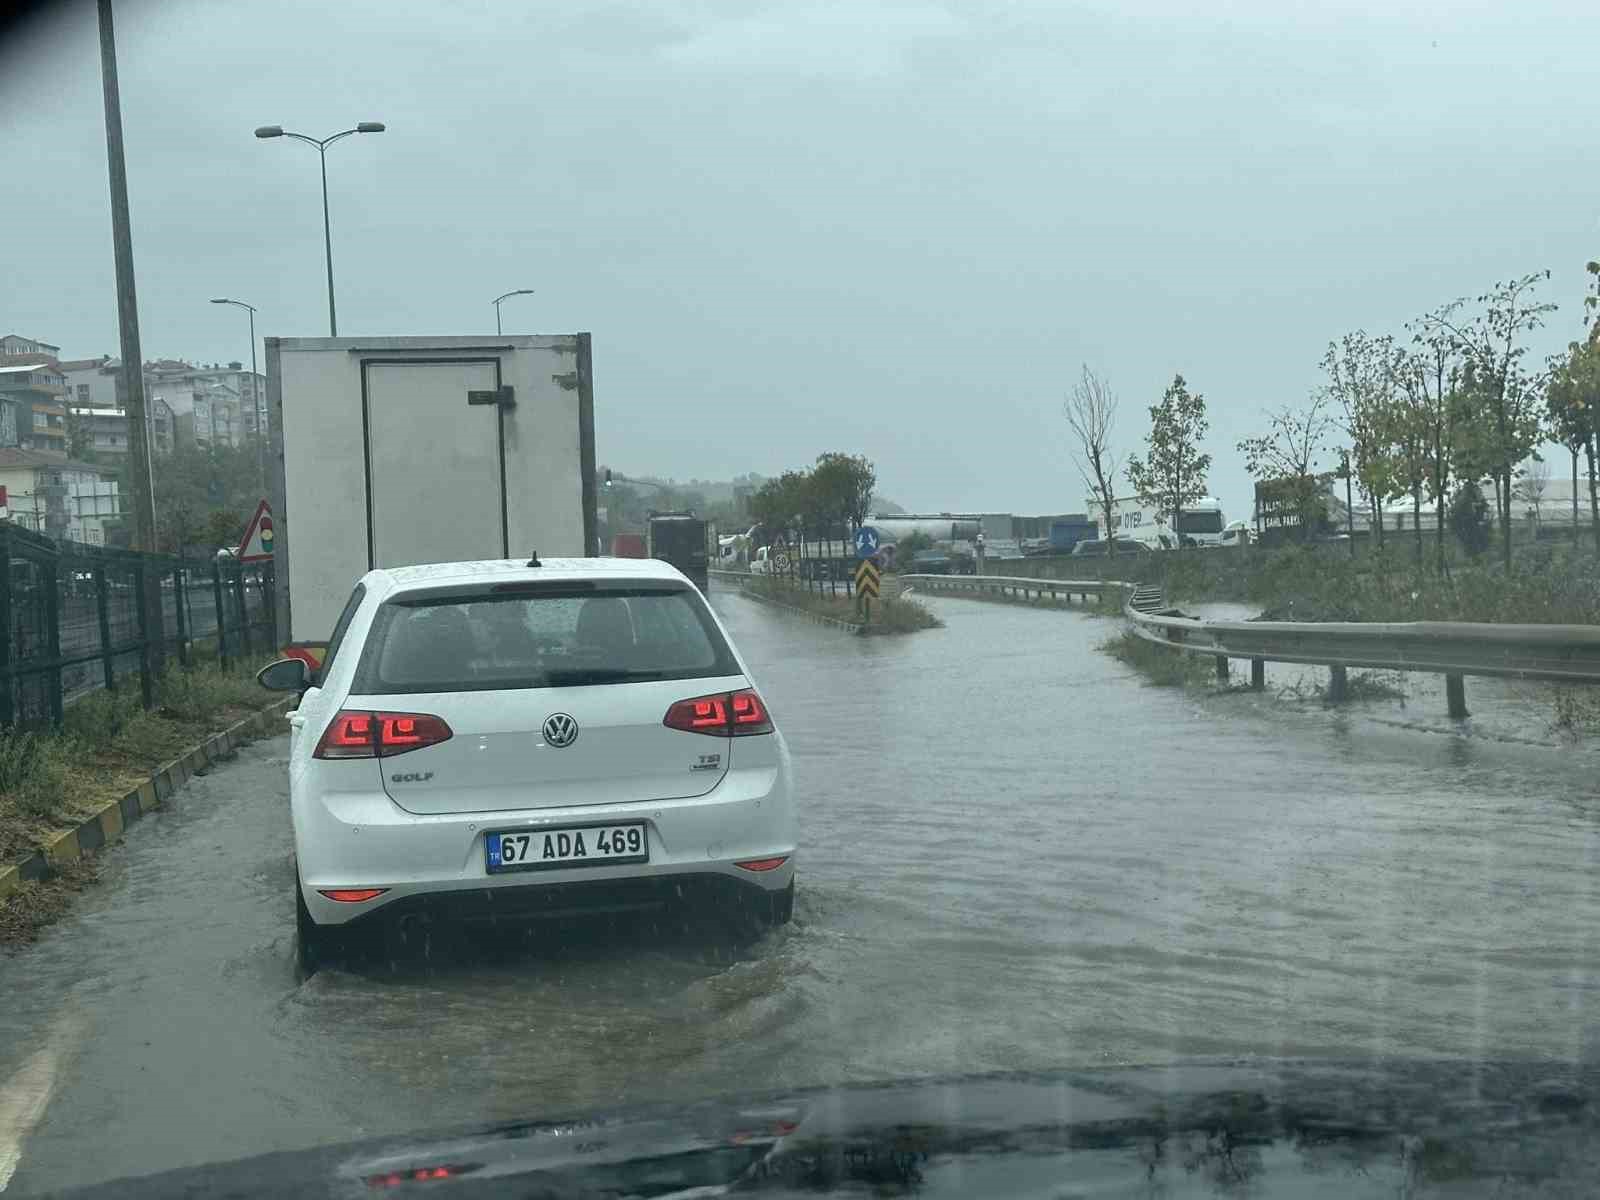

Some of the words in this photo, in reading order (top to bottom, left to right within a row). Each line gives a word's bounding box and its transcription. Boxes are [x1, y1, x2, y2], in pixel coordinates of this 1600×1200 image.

[391, 771, 434, 783] GOLF
[501, 835, 530, 862] 67
[542, 831, 587, 860] ADA
[596, 827, 641, 855] 469
